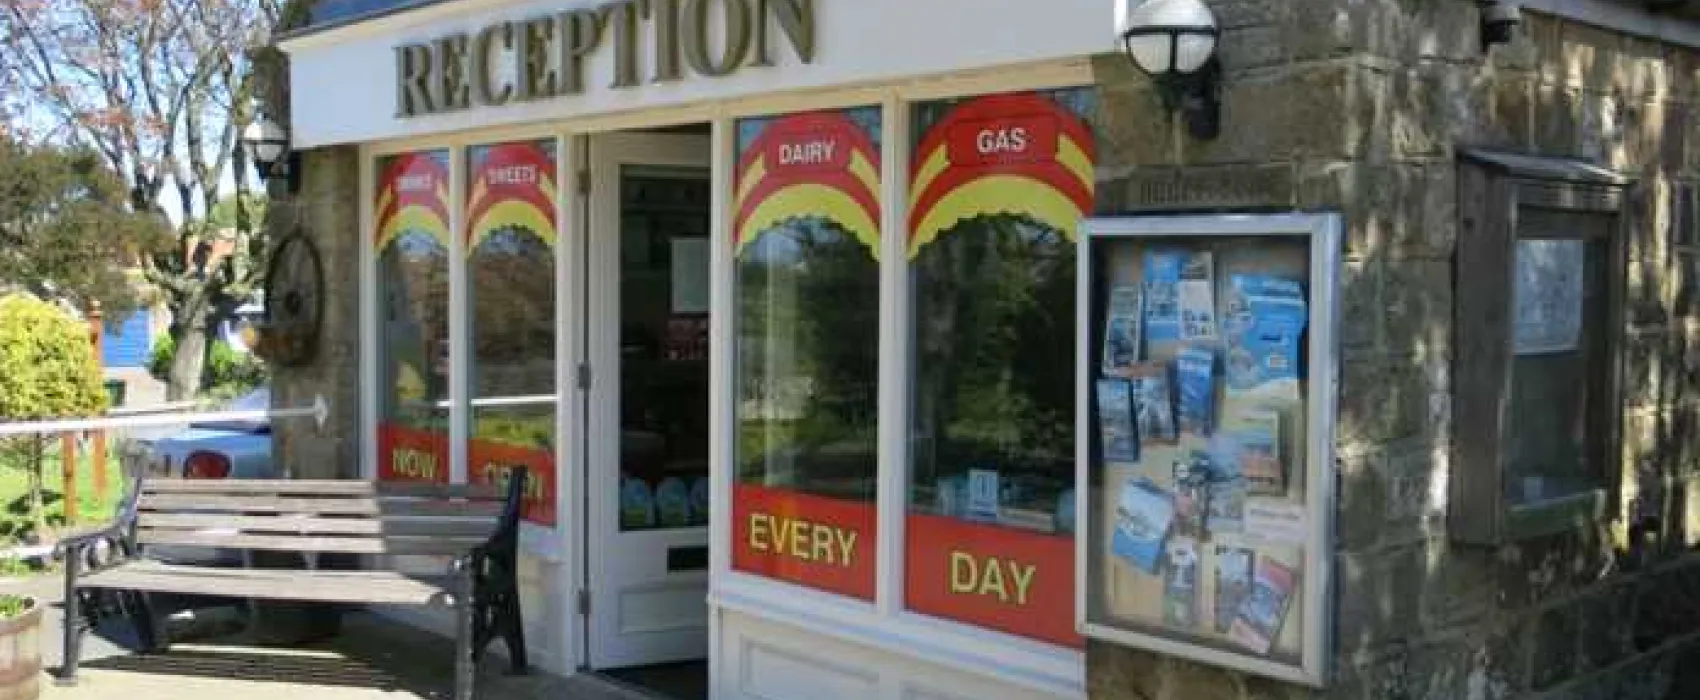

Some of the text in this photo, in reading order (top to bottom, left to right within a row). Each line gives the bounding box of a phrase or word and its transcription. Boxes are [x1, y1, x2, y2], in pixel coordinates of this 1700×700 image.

[393, 0, 816, 118] RECEPTION
[778, 140, 836, 166] DAIRY
[976, 127, 1027, 153] GAS
[487, 164, 538, 185] SWEETS
[392, 447, 438, 479] NOW
[484, 461, 544, 500] OPN
[750, 513, 858, 568] EVERY
[950, 551, 1036, 606] DAY
